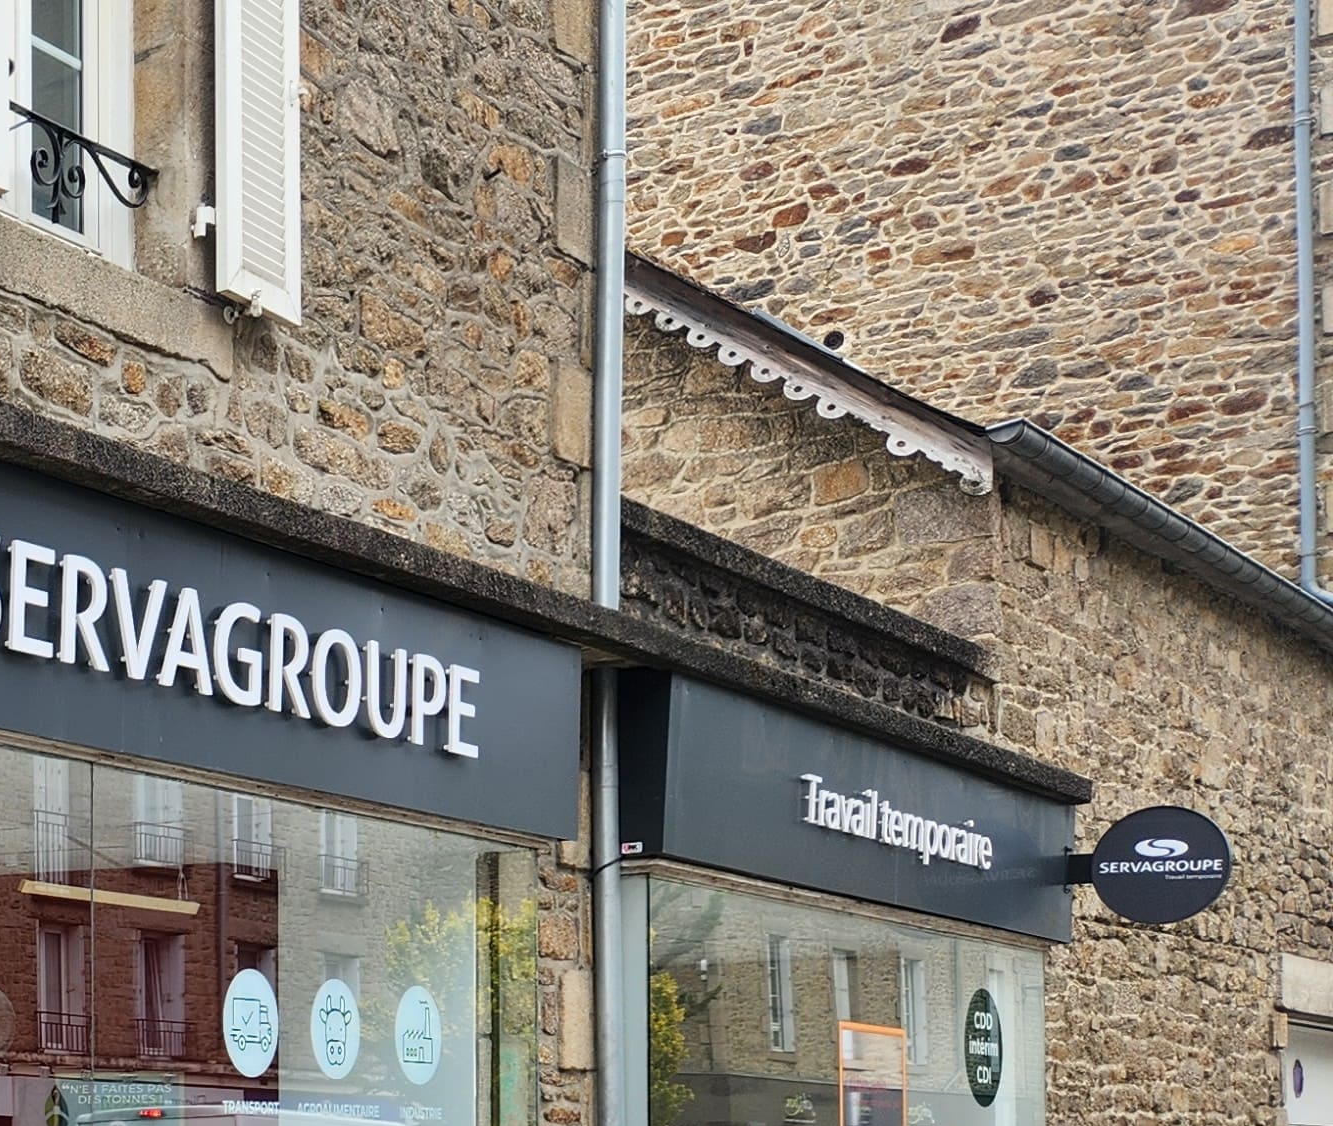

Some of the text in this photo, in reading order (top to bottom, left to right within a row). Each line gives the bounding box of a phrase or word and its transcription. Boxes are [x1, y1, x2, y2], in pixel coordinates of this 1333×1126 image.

[800, 773, 993, 870] Travail temporaire
[1099, 859, 1223, 874] SERVAGROUPE
[974, 1011, 992, 1030] CDD
[969, 1036, 998, 1057] intérim
[977, 1066, 992, 1084] CDI
[102, 1083, 143, 1094] FAITES
[148, 1083, 172, 1094] PAS
[103, 1094, 156, 1104] TONNES
[222, 1100, 281, 1114] TRANSPORT
[297, 1101, 380, 1118] AGROALIMENTAIRE
[399, 1105, 442, 1120] INDUSTRIE
